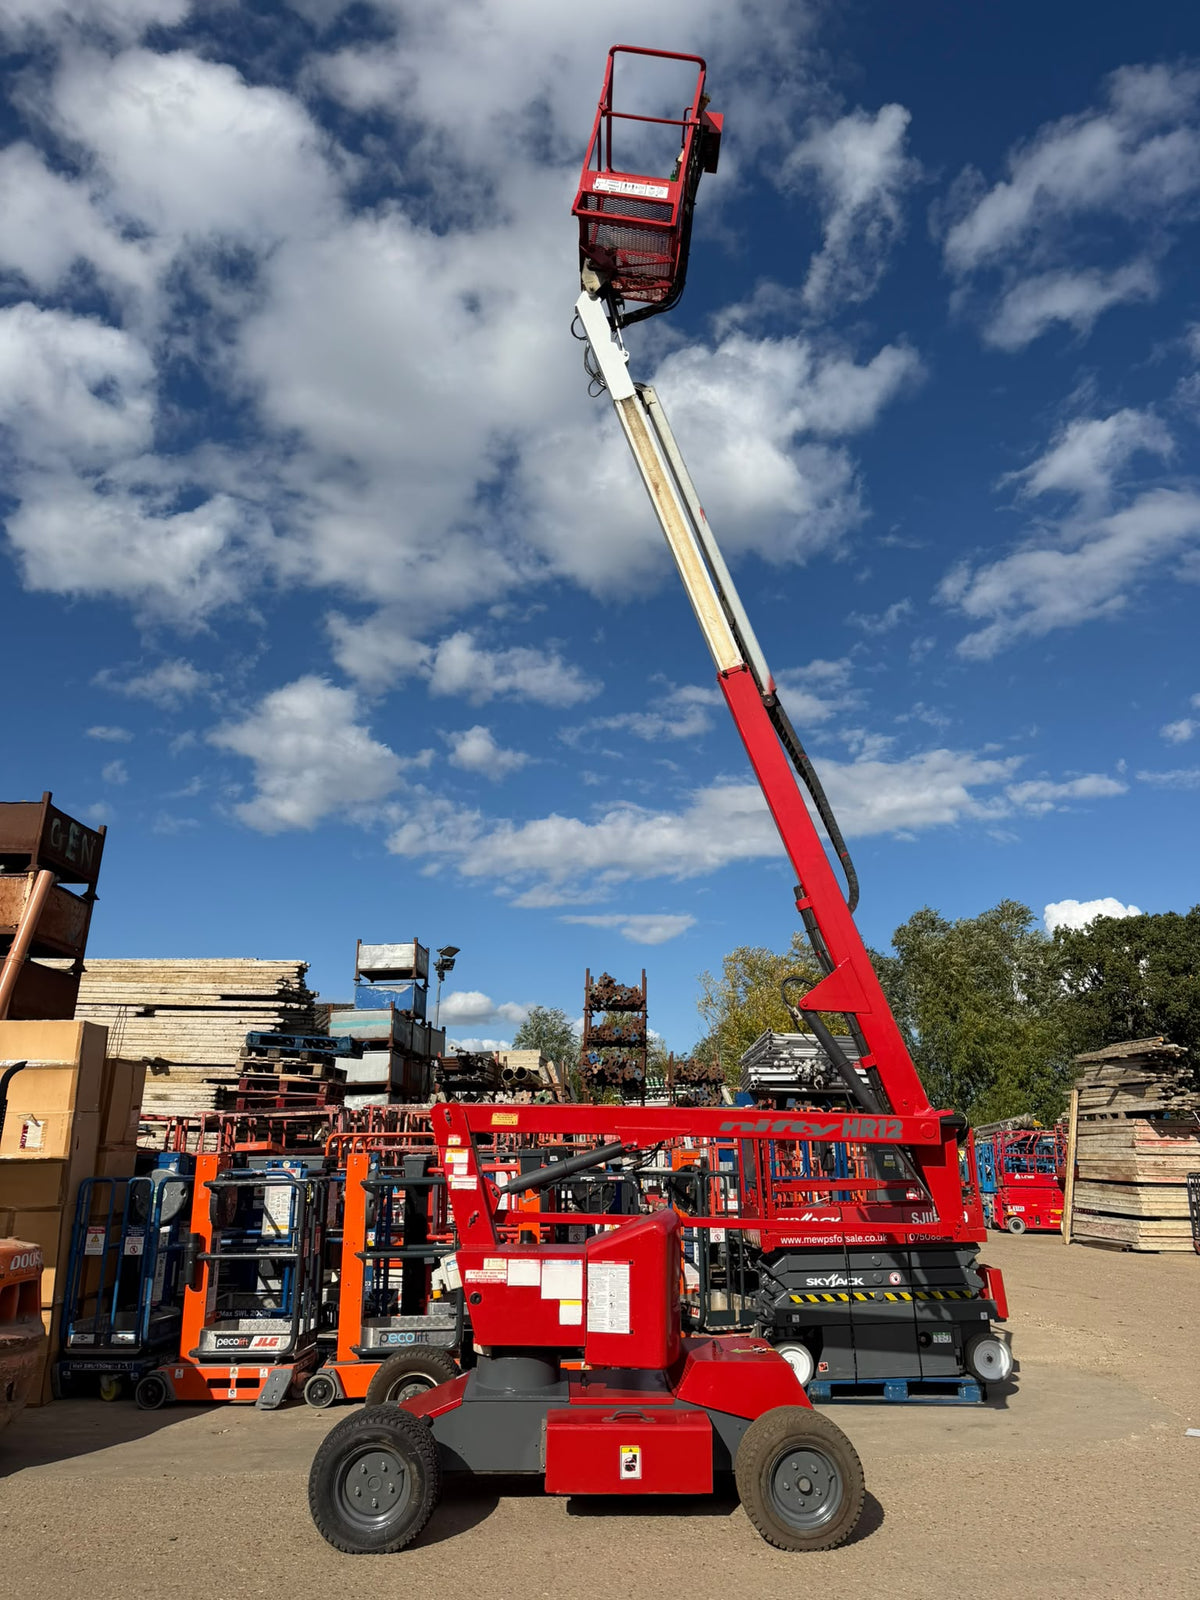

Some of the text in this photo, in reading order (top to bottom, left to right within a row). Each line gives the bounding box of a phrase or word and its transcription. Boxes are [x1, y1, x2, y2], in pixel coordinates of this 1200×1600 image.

[51, 817, 97, 866] GEN
[719, 1118, 904, 1139] nifty HR12
[806, 1273, 865, 1288] SKYJACK
[216, 1336, 280, 1348] pecolift JLG
[379, 1330, 430, 1347] pecolift
